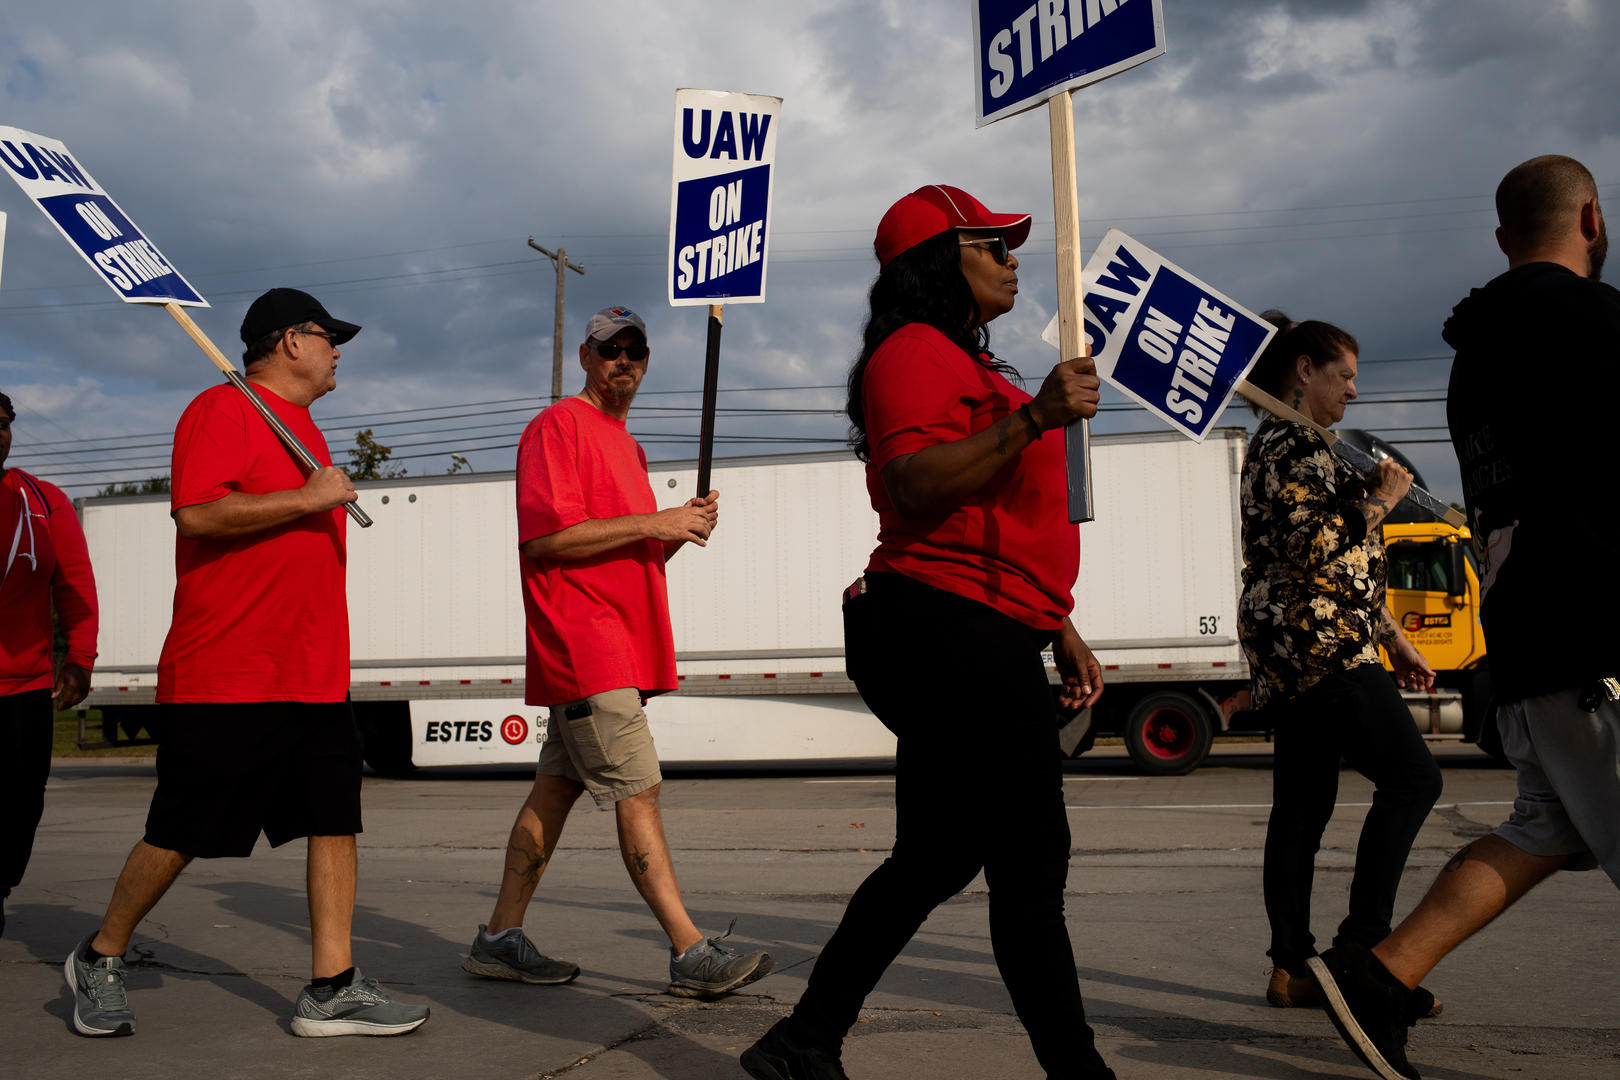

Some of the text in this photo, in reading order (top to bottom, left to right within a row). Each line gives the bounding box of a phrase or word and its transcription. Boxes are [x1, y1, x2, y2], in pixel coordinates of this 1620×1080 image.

[988, 0, 1129, 99] STRI
[682, 108, 772, 161] UAW
[0, 140, 94, 191] UAW
[75, 201, 123, 240] ON
[708, 179, 743, 231] ON
[94, 239, 173, 290] STRIKE
[677, 219, 763, 291] STRIKE
[1138, 306, 1183, 364] ON
[1166, 298, 1236, 425] STRIKE
[426, 721, 493, 742] ESTES
